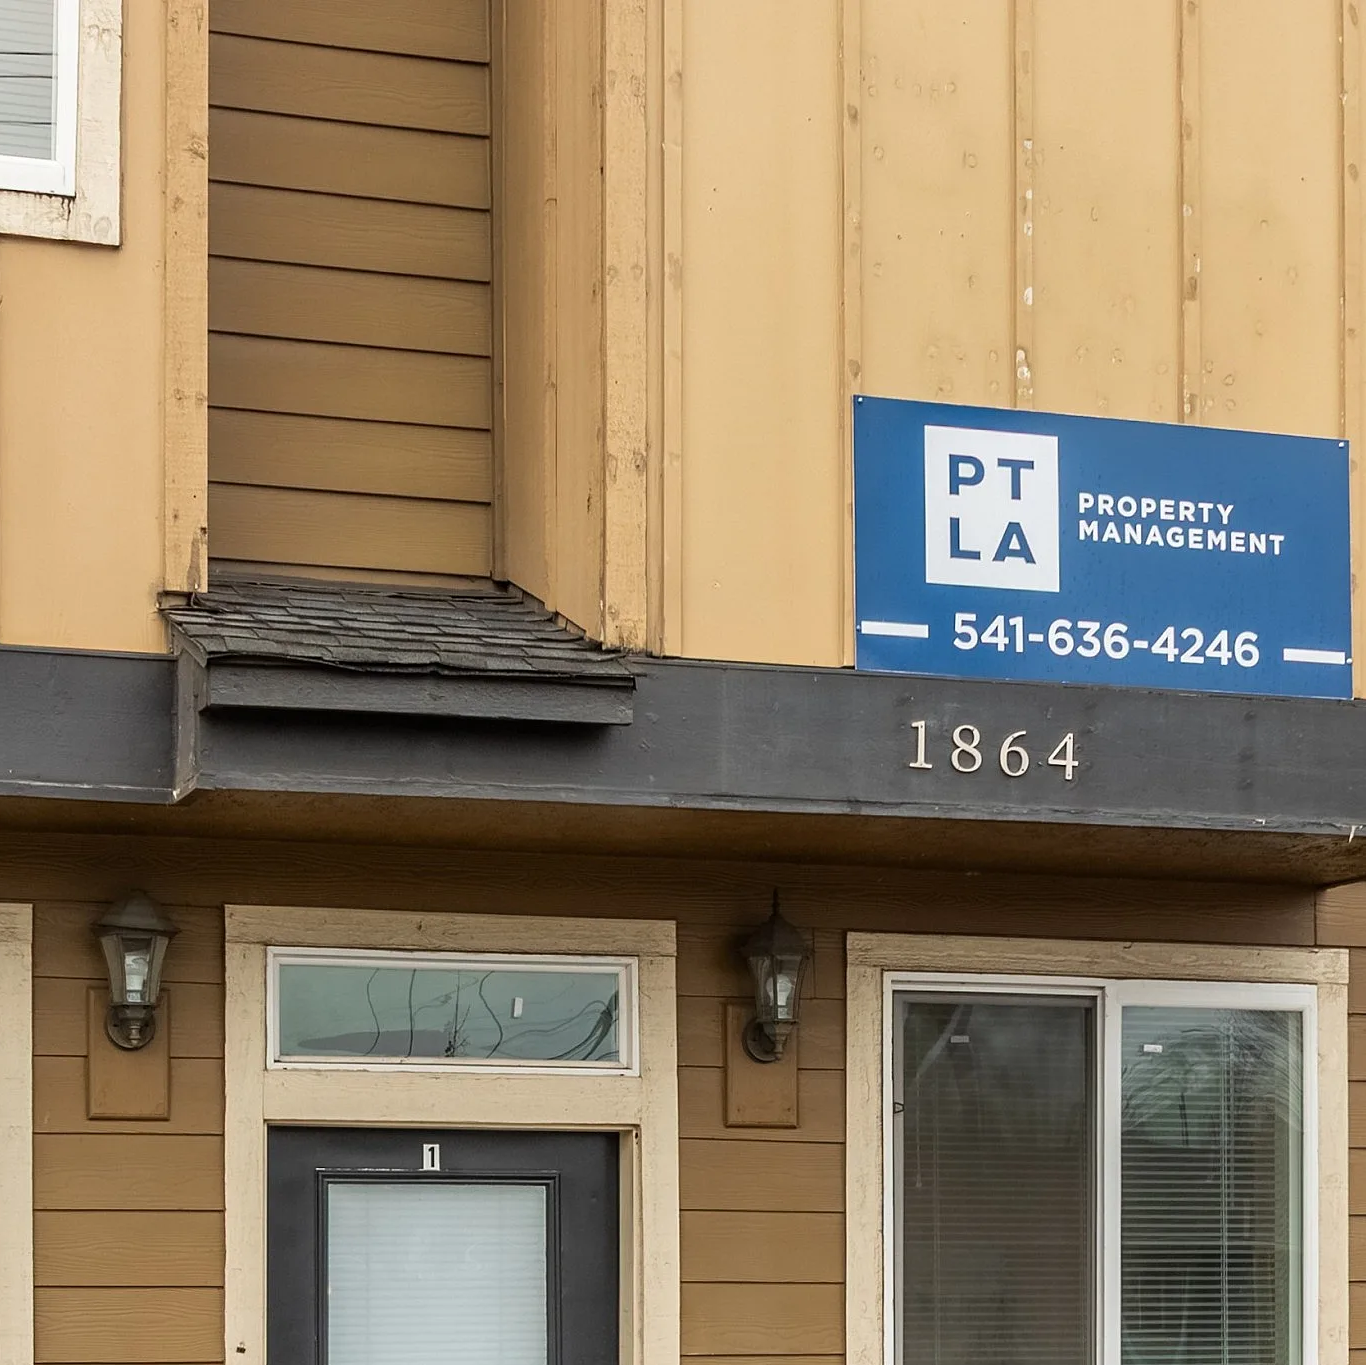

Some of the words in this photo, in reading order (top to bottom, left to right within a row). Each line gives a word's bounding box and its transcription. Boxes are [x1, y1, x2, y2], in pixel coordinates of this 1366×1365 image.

[948, 453, 1035, 501] PT
[1078, 492, 1234, 525] PROPERTY
[949, 516, 1037, 565] LA
[1078, 519, 1285, 556] MANAGEMENT
[953, 612, 1260, 668] 541-636-4246
[909, 720, 1079, 780] 1864
[428, 1146, 435, 1168] 1
